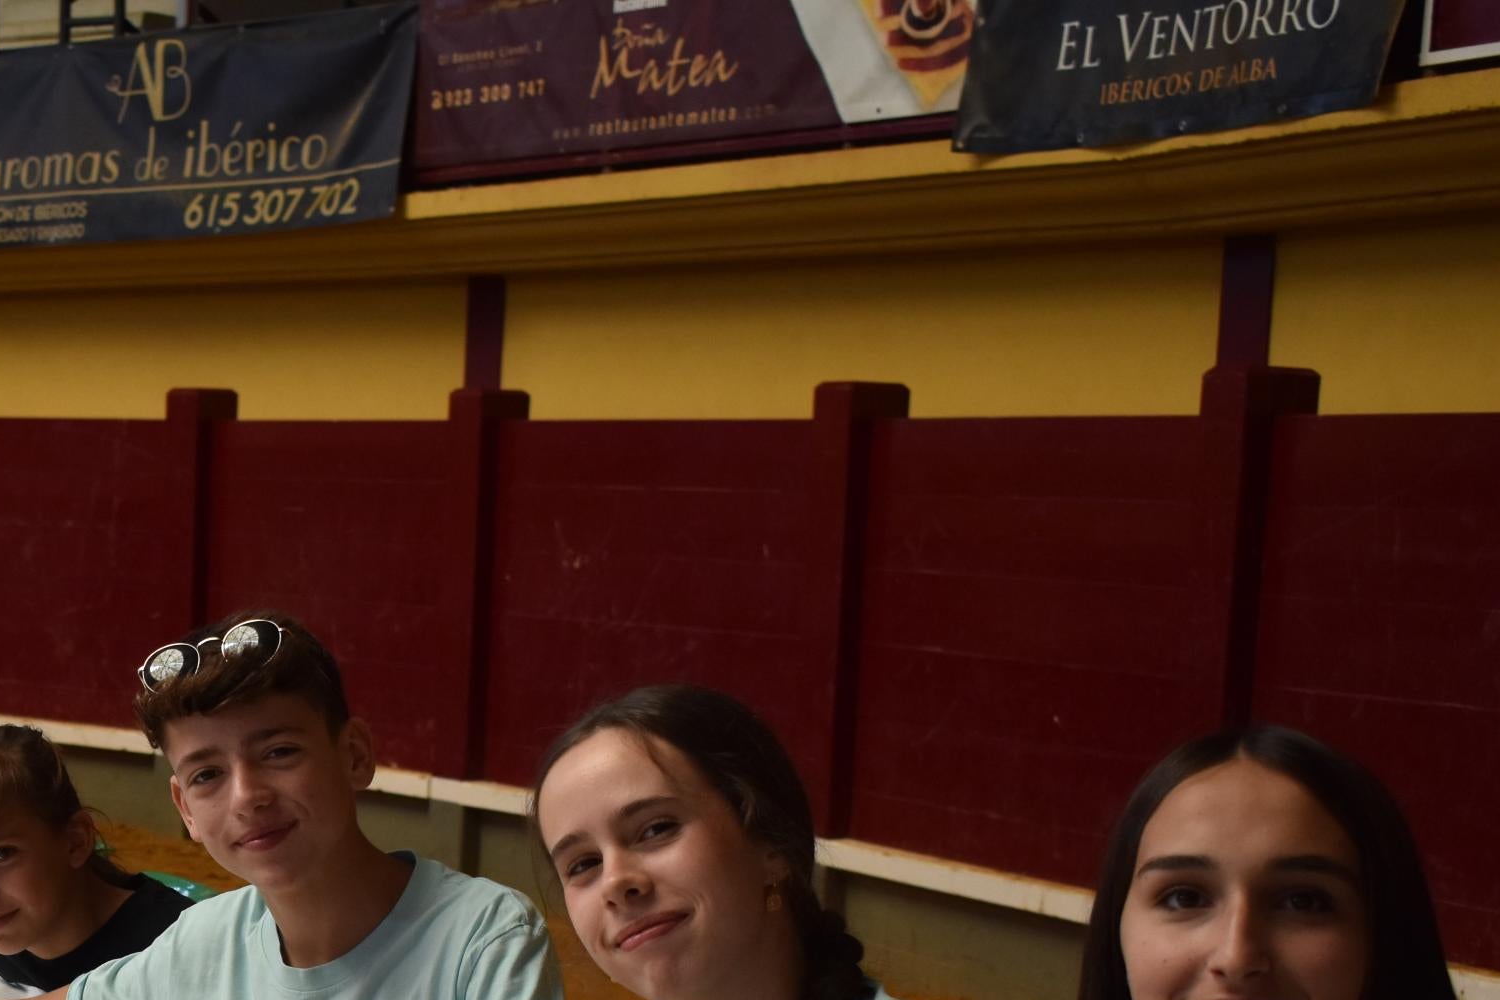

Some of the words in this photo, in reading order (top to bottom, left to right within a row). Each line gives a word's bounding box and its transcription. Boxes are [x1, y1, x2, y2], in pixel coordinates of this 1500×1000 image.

[589, 35, 739, 100] Matea
[1100, 71, 1192, 106] IBÉRICOS
[1199, 66, 1222, 92] DE
[1229, 57, 1277, 83] ALBA
[134, 125, 169, 181] de
[183, 119, 328, 178] ibérico
[184, 193, 239, 229] 615
[243, 189, 304, 224] 307
[304, 178, 360, 218] 702
